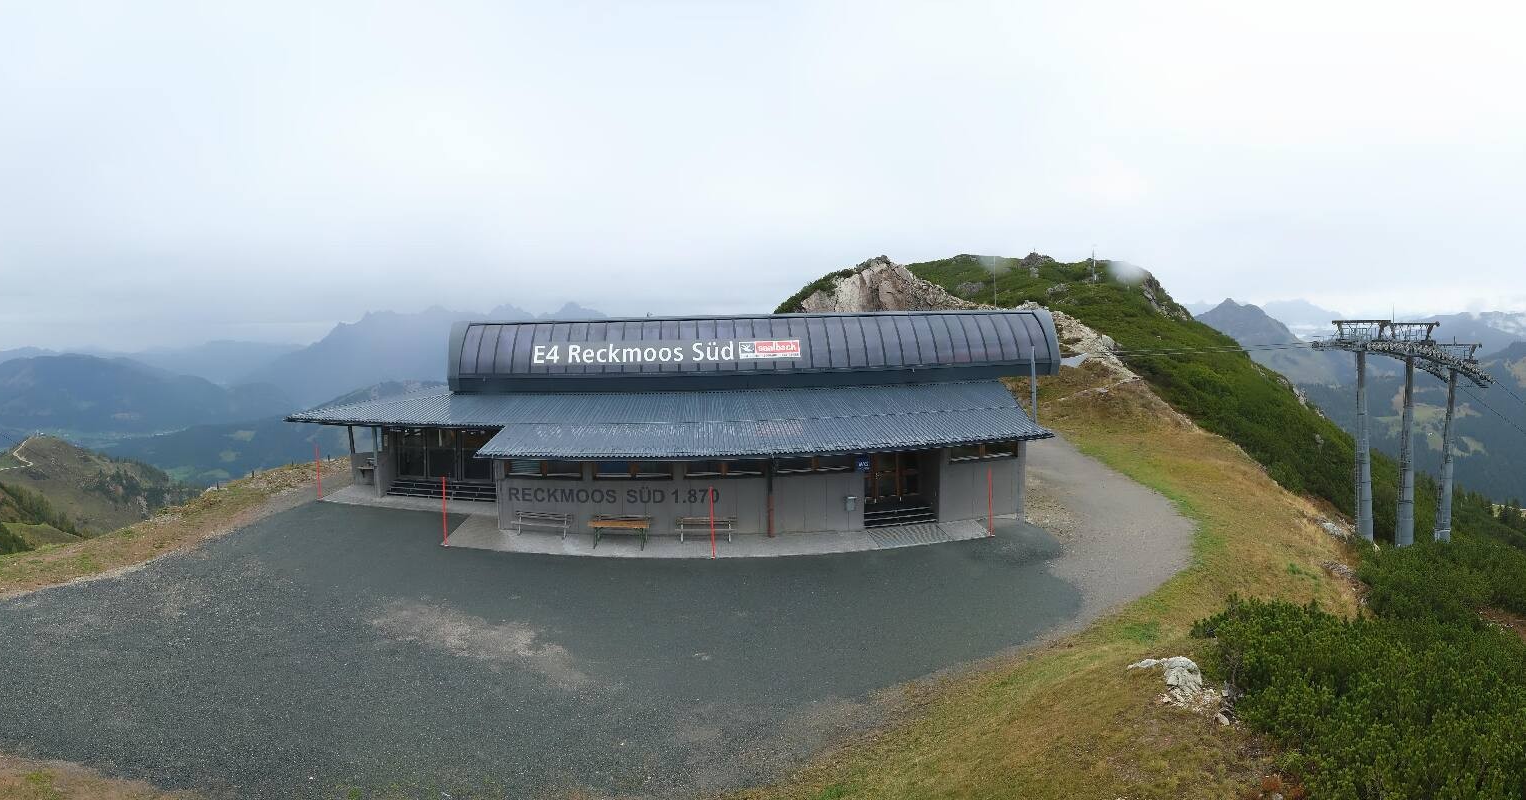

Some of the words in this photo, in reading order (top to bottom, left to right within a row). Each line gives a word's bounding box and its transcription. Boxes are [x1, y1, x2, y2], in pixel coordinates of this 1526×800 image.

[533, 344, 560, 364] E4
[568, 343, 684, 363] Reckmoos
[692, 341, 734, 361] Süd
[508, 487, 617, 504] RECKMOOS
[627, 486, 665, 504] SÜD
[671, 488, 720, 504] 1.870
